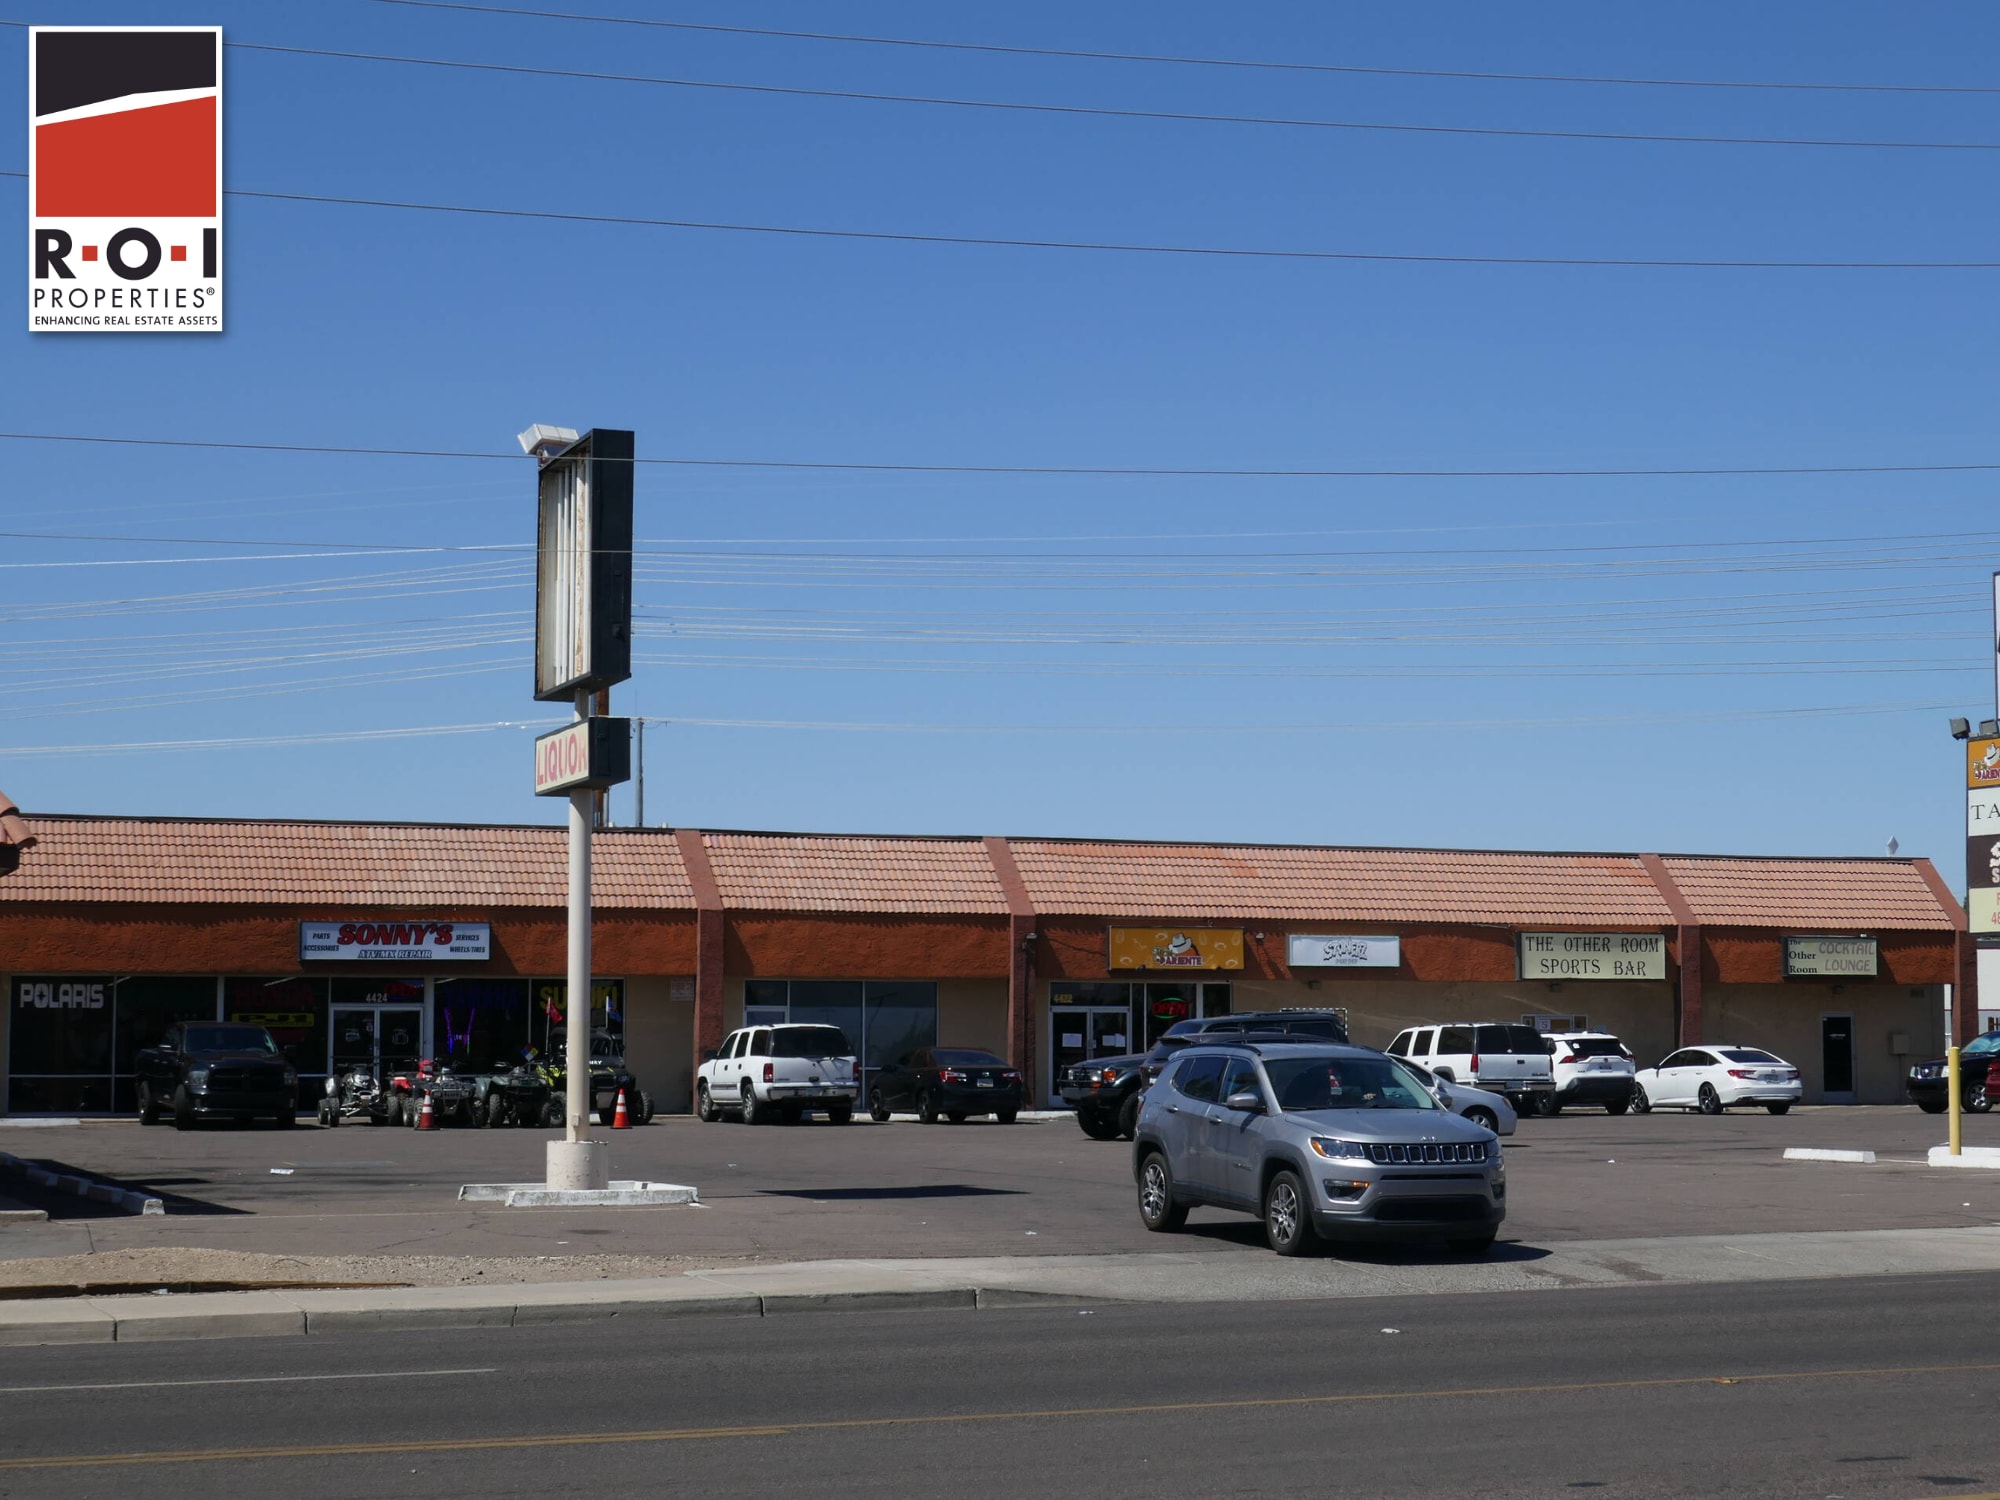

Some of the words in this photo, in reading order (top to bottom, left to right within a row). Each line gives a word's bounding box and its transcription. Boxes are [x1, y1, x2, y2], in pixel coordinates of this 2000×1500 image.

[312, 932, 331, 940] PARTS
[337, 922, 454, 946] SONNY'S
[455, 933, 480, 942] SERVICES
[303, 944, 340, 952] ACCESSORIES
[1525, 936, 1554, 952] THE
[1564, 936, 1612, 954] OTHER
[1620, 937, 1660, 954] ROOM
[1819, 942, 1875, 956] COCKTAIL
[397, 949, 433, 959] REPAIR
[1788, 950, 1817, 960] Other
[1540, 958, 1601, 975] SPORTS
[1613, 960, 1647, 977] BAR
[1789, 965, 1818, 974] Room
[1824, 959, 1871, 972] LOUNGE
[20, 983, 105, 1009] POLARIS
[365, 992, 388, 1003] 4424
[1151, 1001, 1189, 1016] OPEN
